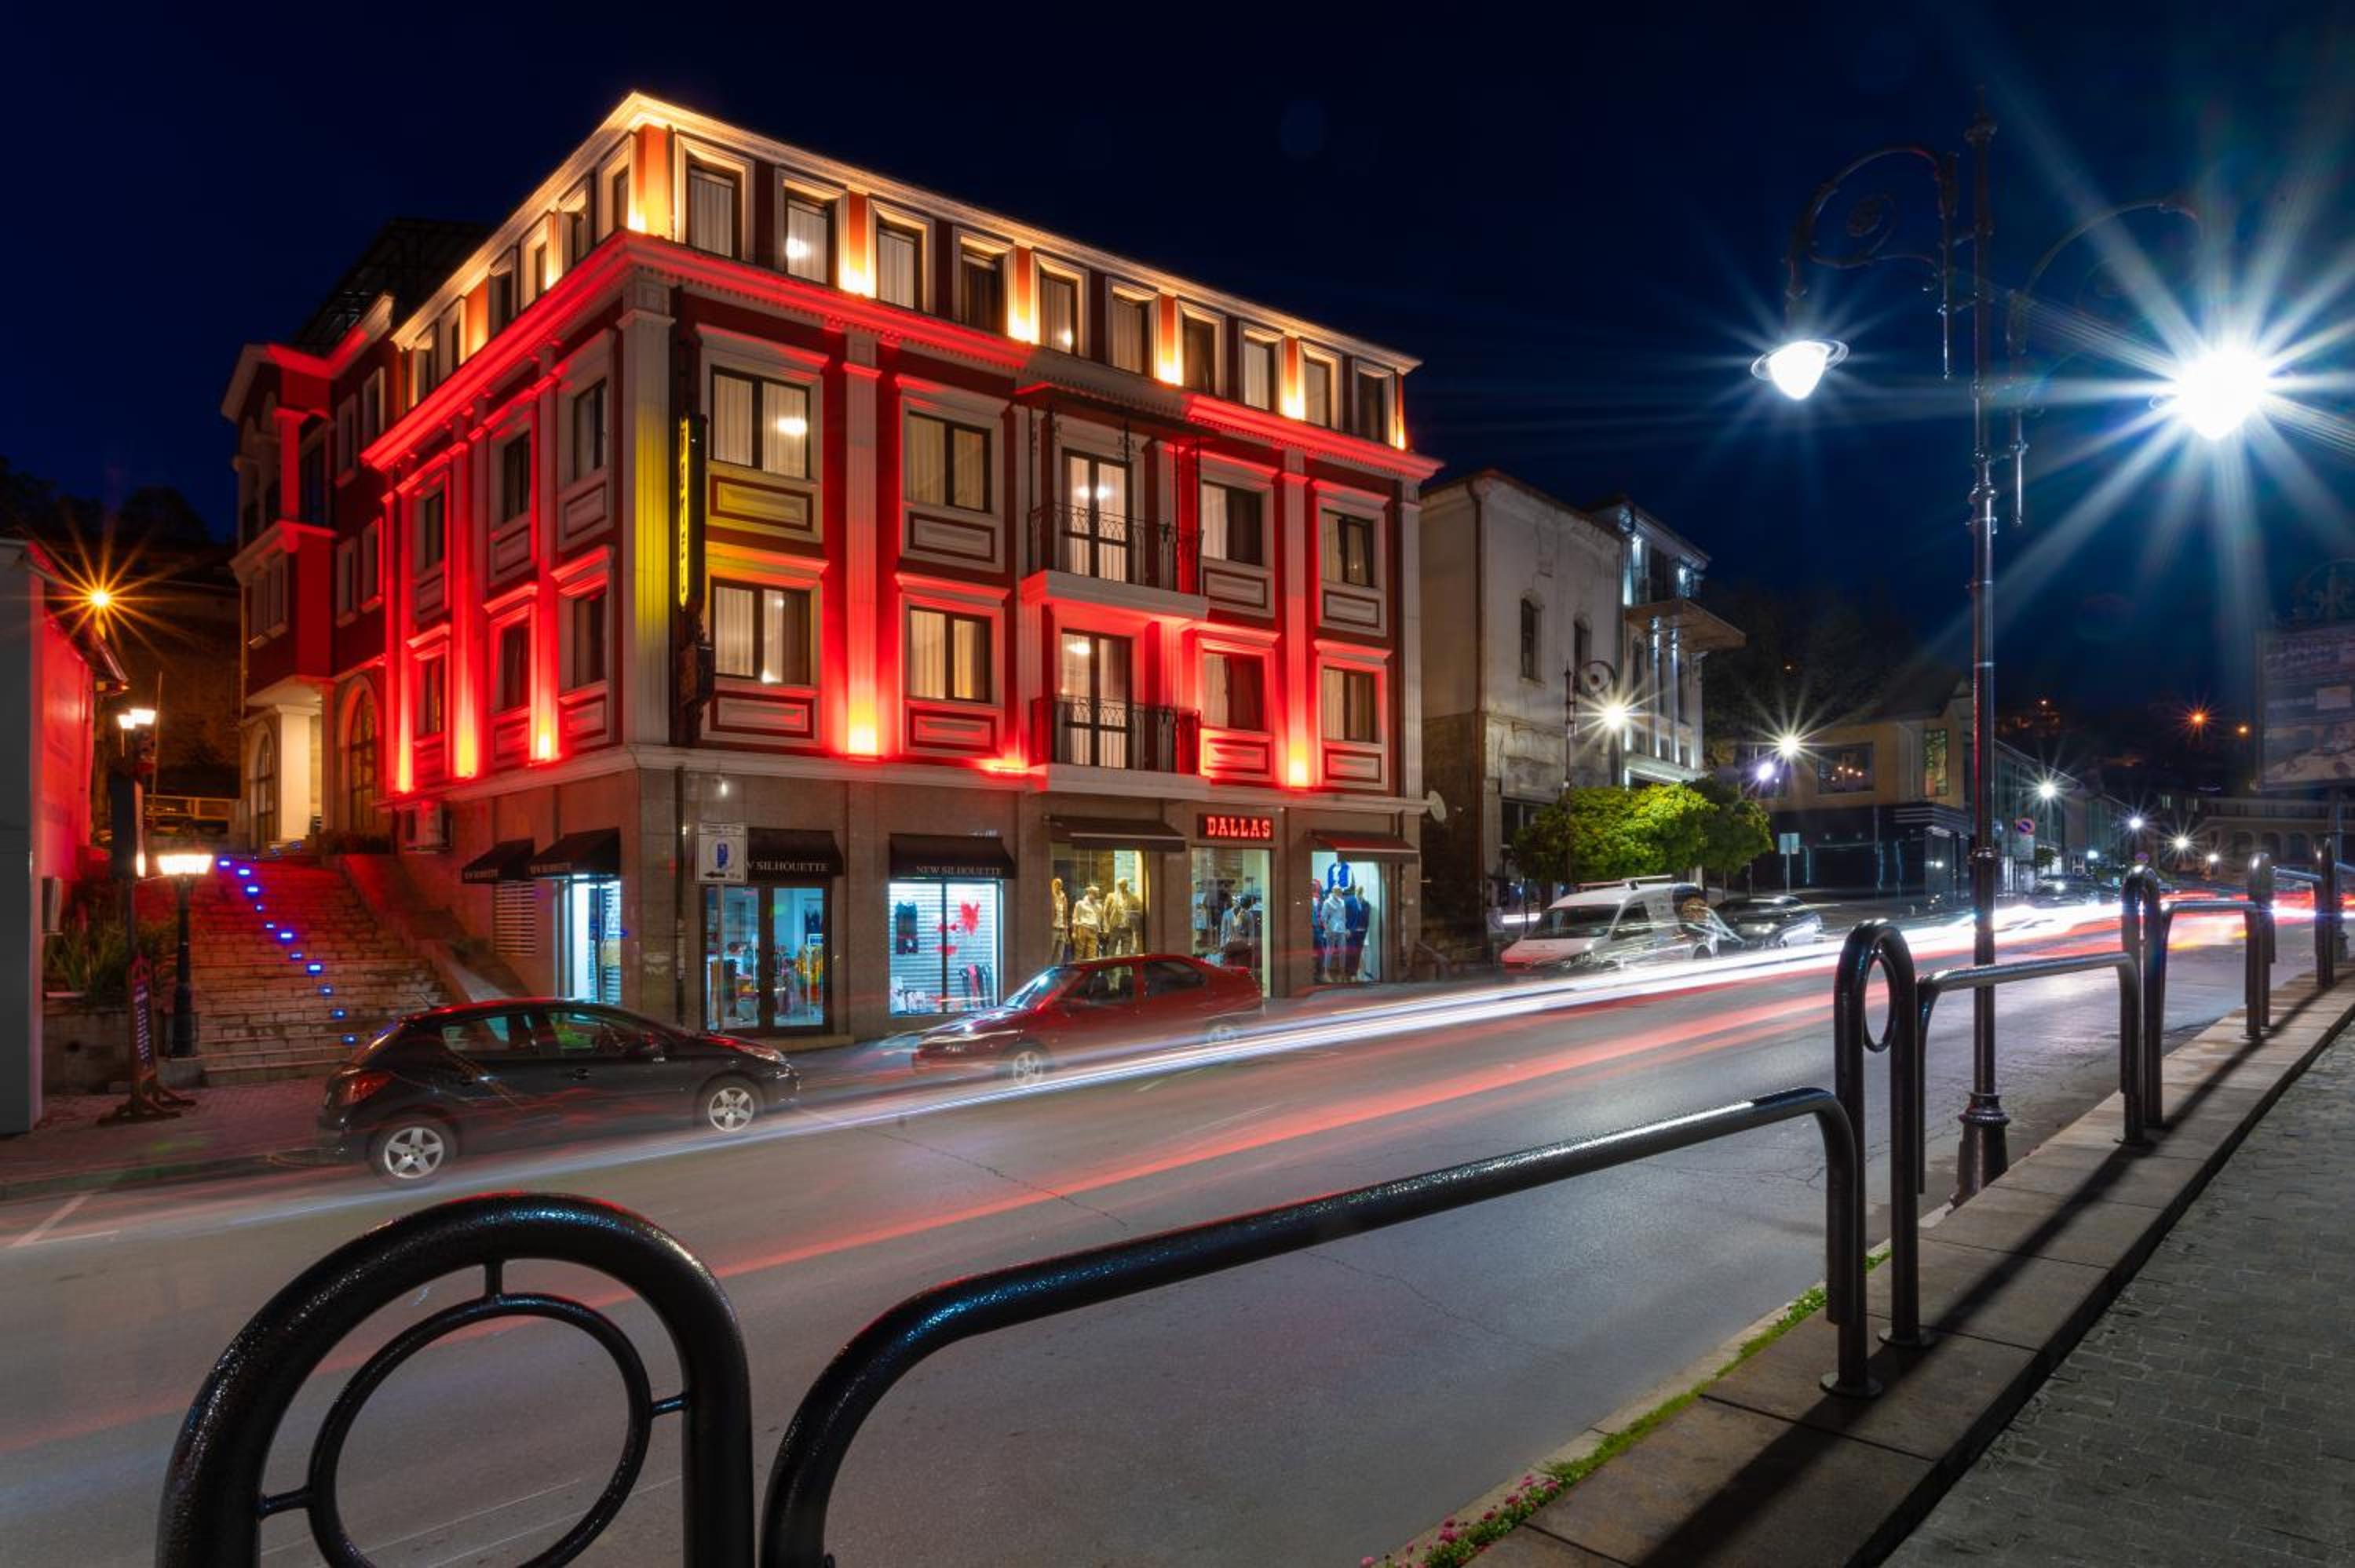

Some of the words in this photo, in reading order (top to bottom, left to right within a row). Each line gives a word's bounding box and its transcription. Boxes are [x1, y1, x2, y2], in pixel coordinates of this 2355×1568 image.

[1207, 816, 1271, 838] DALLAS
[755, 860, 830, 873] SILHOUETTE
[916, 866, 940, 874] NEW
